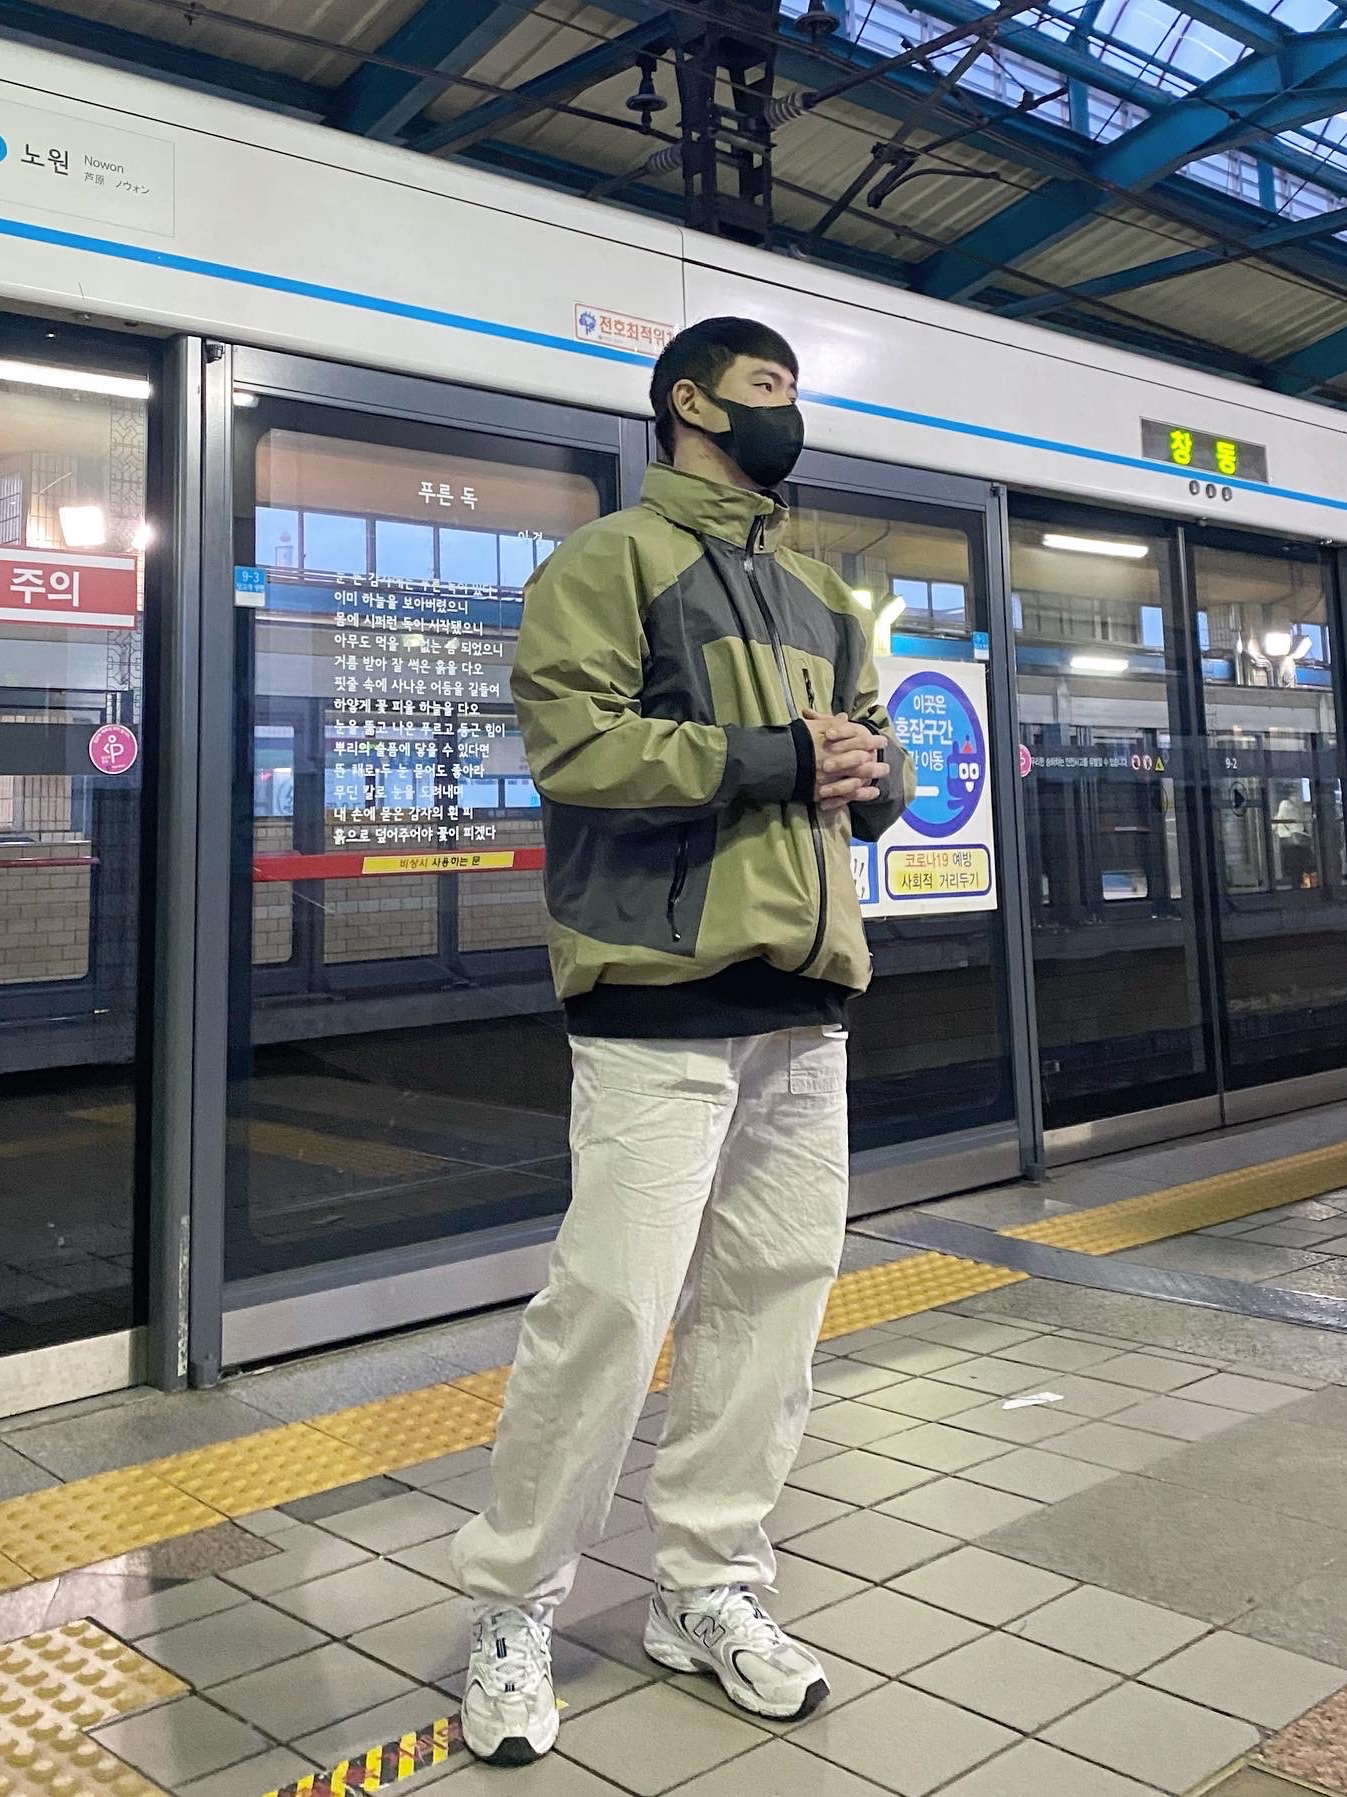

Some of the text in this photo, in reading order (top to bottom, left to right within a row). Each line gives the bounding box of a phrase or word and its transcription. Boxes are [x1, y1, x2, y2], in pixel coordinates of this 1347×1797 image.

[21, 144, 68, 176] 노원
[84, 154, 124, 174] Nowon
[1170, 430, 1236, 475] 창 동
[418, 481, 478, 511] 푸른 독
[242, 571, 259, 583] 9-3
[10, 568, 80, 607] 주의
[334, 591, 468, 614] 이미 하늘을 보아버렸으니
[334, 612, 359, 627] 몸에
[364, 614, 397, 631] 시퍼런
[334, 633, 371, 649] 아무도
[376, 636, 398, 652] 먹을
[461, 642, 503, 657] 되었으니
[334, 655, 484, 676] 거름 받아 잘 썩은 흙을 다오
[334, 676, 500, 697] 핏줄 속에 사나운 어둠을 길들여
[334, 698, 480, 716] 하얗게 꽃 피울 하늘을 다오
[914, 695, 946, 714] 이곳은
[334, 720, 505, 738] 눈을 뚫고 나온 푸르고 둥근 힘이
[896, 717, 953, 745] 혼잡구간
[334, 742, 489, 758] 뿌리의 슬픔에 닿을 수 있다면
[922, 750, 944, 771] 이동
[1226, 758, 1238, 769] 9-2
[380, 764, 392, 778] 두
[397, 764, 408, 778] 눈
[451, 764, 484, 778] 좋아라
[334, 785, 358, 800] 무딘
[363, 785, 386, 800] 칼로
[392, 785, 415, 800] 눈을
[334, 808, 346, 821] 내
[350, 807, 376, 821] 손에
[380, 808, 404, 820] 묻은
[409, 806, 443, 821] 감자의
[448, 807, 458, 820] 흰
[463, 807, 473, 820] 피
[333, 826, 496, 845] 흙으로 덮어주어야 꽃이 피겠다
[400, 856, 481, 869] 비상시 사용하는 문
[906, 851, 972, 868] 코로나19 예방
[902, 873, 979, 890] 사회적 거리두기
